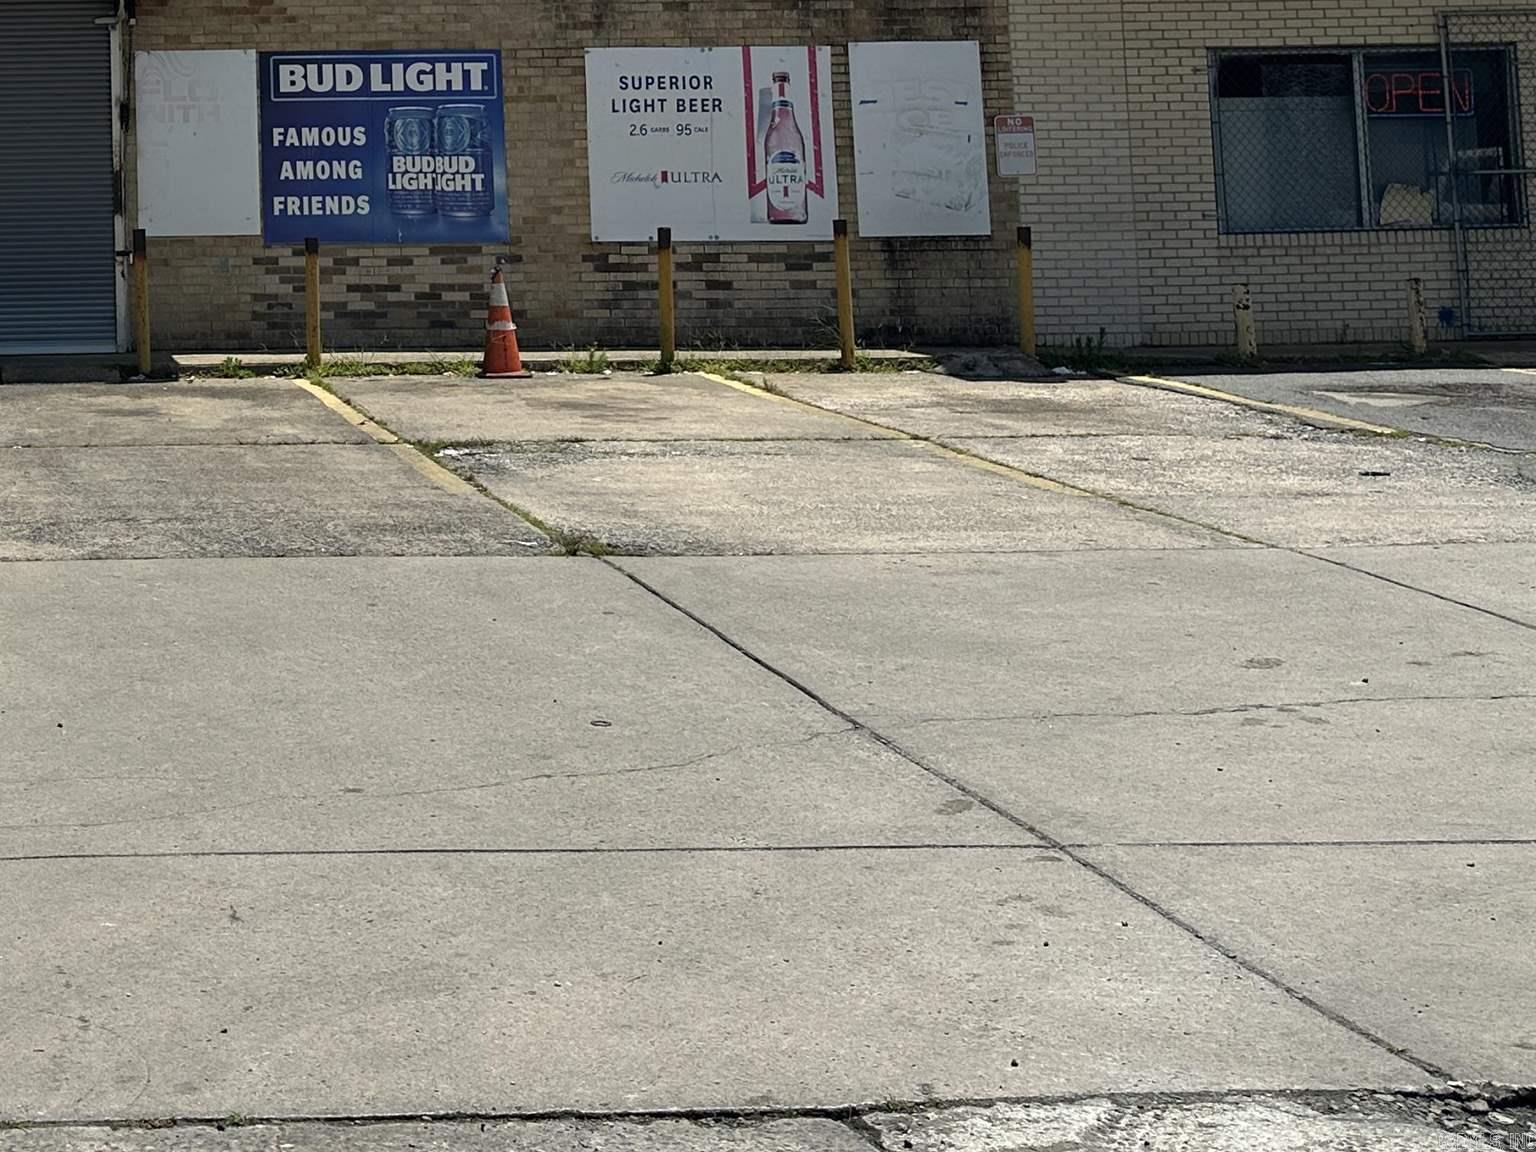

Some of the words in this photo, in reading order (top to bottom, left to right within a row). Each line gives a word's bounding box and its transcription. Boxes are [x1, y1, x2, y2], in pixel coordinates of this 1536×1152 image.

[278, 63, 364, 93] BUD
[370, 61, 488, 92] LIGHT
[619, 75, 714, 90] SUPERIOR
[1365, 72, 1471, 112] OPEN
[611, 98, 667, 113] LIGHT
[676, 98, 723, 113] BEER
[676, 123, 692, 136] 95
[1007, 118, 1023, 126] NO
[273, 127, 366, 146] FAMOUS
[279, 160, 363, 180] AMONG
[393, 156, 435, 173] BUD
[435, 156, 475, 174] BUD
[388, 173, 436, 190] LIGH
[435, 174, 484, 191] IGHT
[670, 172, 723, 183] ULTRA
[768, 174, 803, 184] ULTRA
[273, 196, 370, 216] FRIENDS
